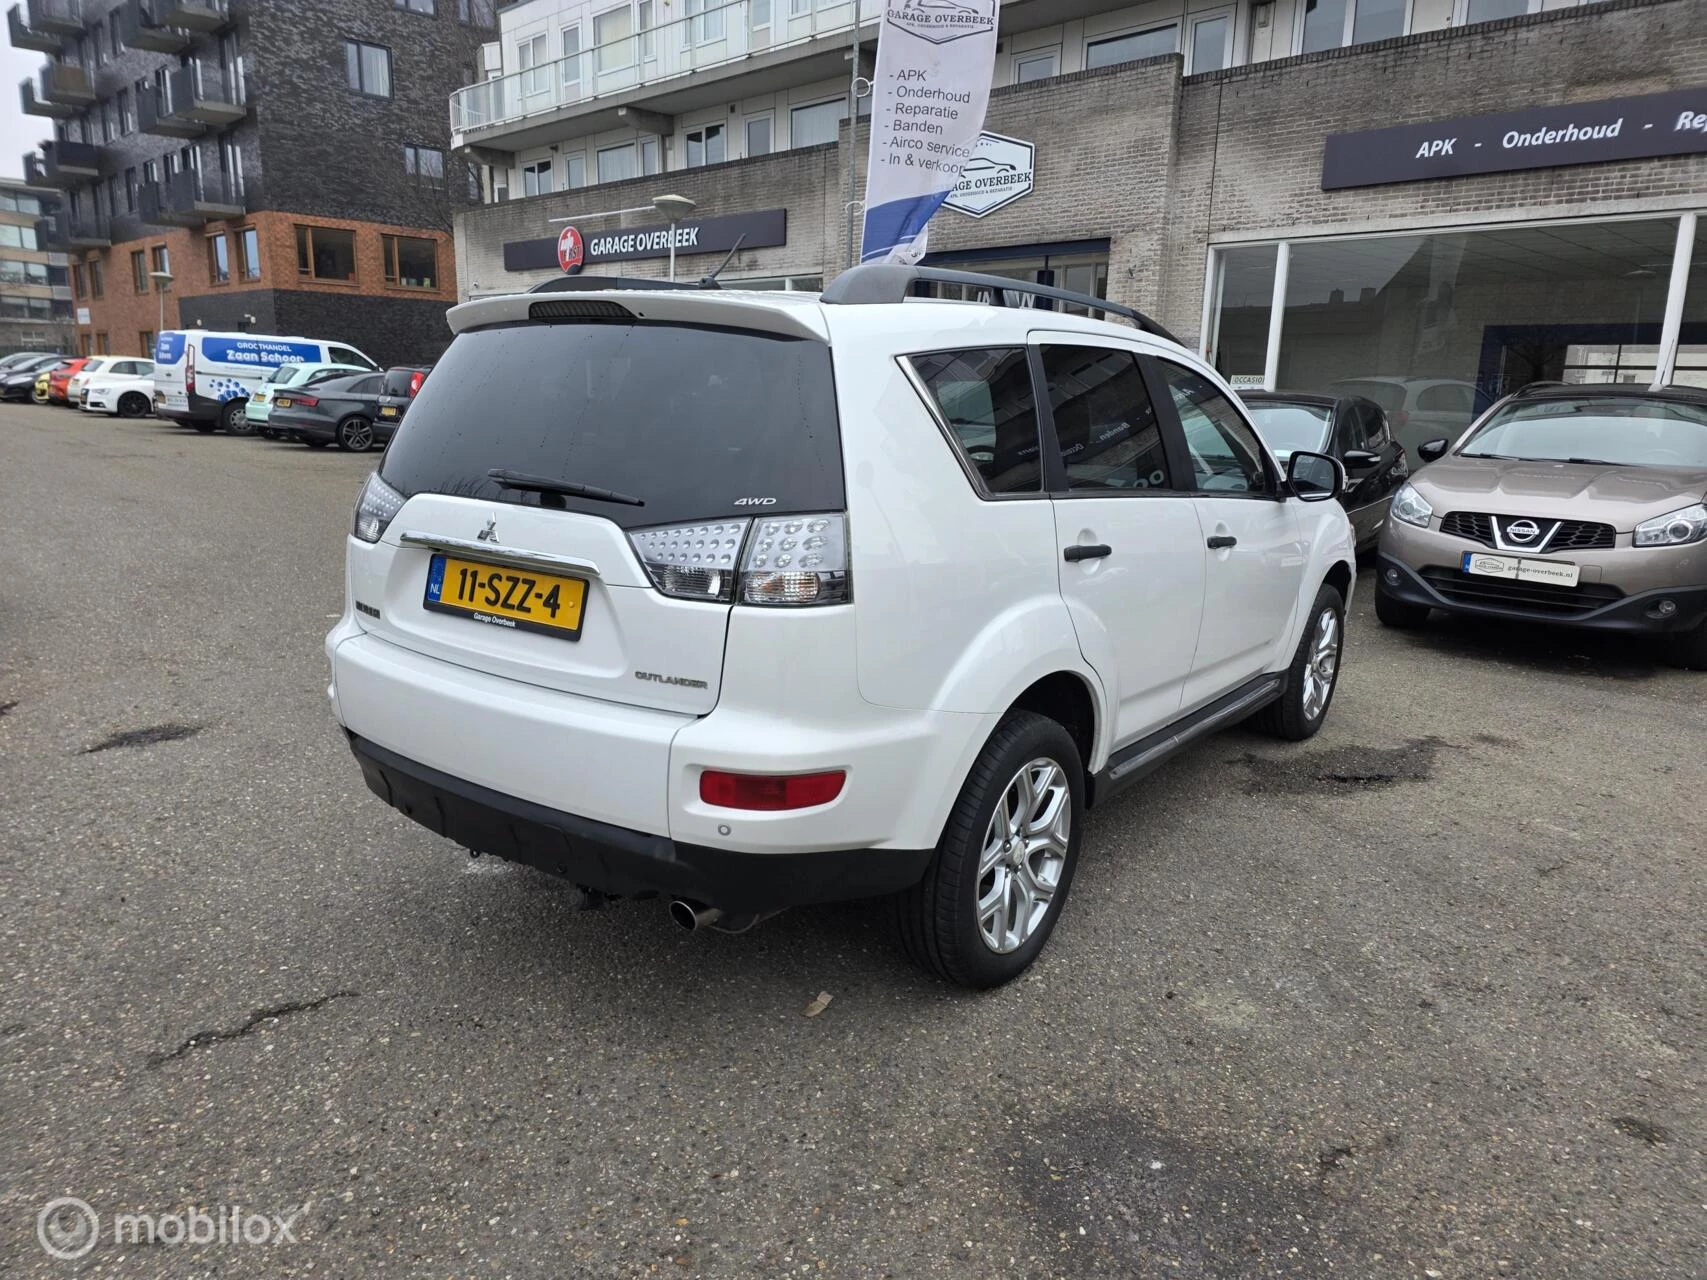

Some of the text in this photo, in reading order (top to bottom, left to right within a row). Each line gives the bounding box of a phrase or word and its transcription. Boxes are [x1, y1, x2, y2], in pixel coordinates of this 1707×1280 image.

[887, 9, 994, 25] GARAGE OVERBEEK
[896, 69, 927, 81] APK
[896, 85, 971, 103] Onderhoud
[895, 102, 958, 120] Reparatie
[893, 119, 943, 135] Banden
[889, 136, 923, 150] Airco
[926, 141, 970, 158] service
[1415, 137, 1458, 159] APK
[1502, 118, 1624, 149] Onderhoud
[889, 153, 900, 165] In
[904, 153, 914, 166] &
[975, 171, 1032, 189] OVERBEEK
[590, 234, 634, 256] GARAGE
[226, 349, 305, 363] Zaan Schoon
[734, 497, 777, 505] 4WD
[430, 583, 440, 595] NL
[458, 567, 561, 619] 11-SZZ-4
[473, 612, 516, 628] Garage Overbeek
[635, 671, 708, 690] OUTLANDER
